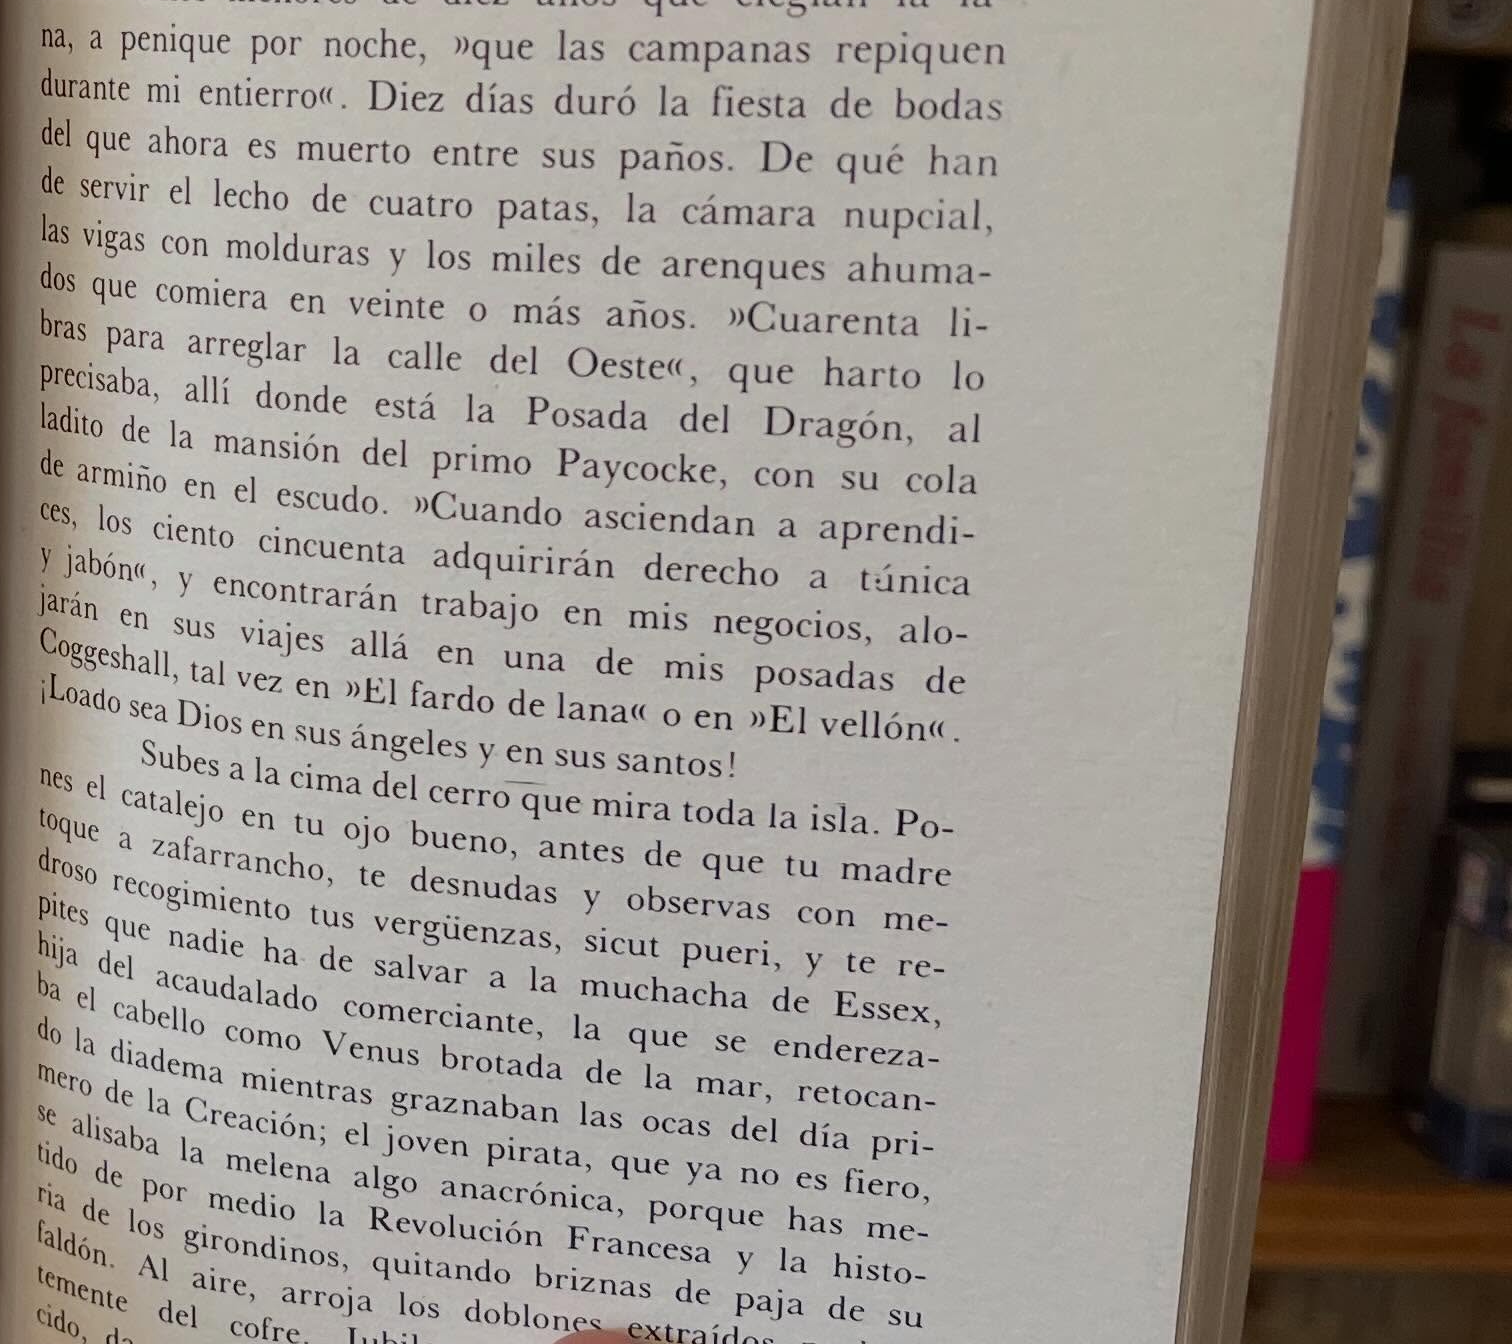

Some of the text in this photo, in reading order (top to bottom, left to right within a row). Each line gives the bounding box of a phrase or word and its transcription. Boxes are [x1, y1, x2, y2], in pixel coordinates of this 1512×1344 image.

[40, 66, 131, 102] durante
[146, 73, 181, 104] mi
[367, 79, 445, 113] Diez
[465, 81, 534, 115] días
[554, 83, 637, 117] duró
[659, 84, 689, 117] la
[711, 84, 807, 119] fiesta
[829, 85, 873, 119] de
[895, 87, 1002, 121] bodas
[40, 307, 87, 342] bras
[105, 326, 165, 355] para
[187, 330, 307, 369] arreglar
[332, 335, 361, 367] la
[387, 340, 463, 372] calle
[489, 343, 539, 376] del
[728, 362, 795, 394] que
[823, 355, 921, 390] harto
[953, 359, 985, 391] lo
[39, 502, 971, 597] ces, los ciento cincuenta adquirirán derecho a túnica
[41, 672, 736, 779] ¡Loado sea Dios en sus ángeles y en sus santos!
[37, 929, 940, 1069] hija del acaudalado comerciante, la que se endereza-
[37, 1141, 927, 1285] tido de por medio la Revolución Francesa y la histo-
